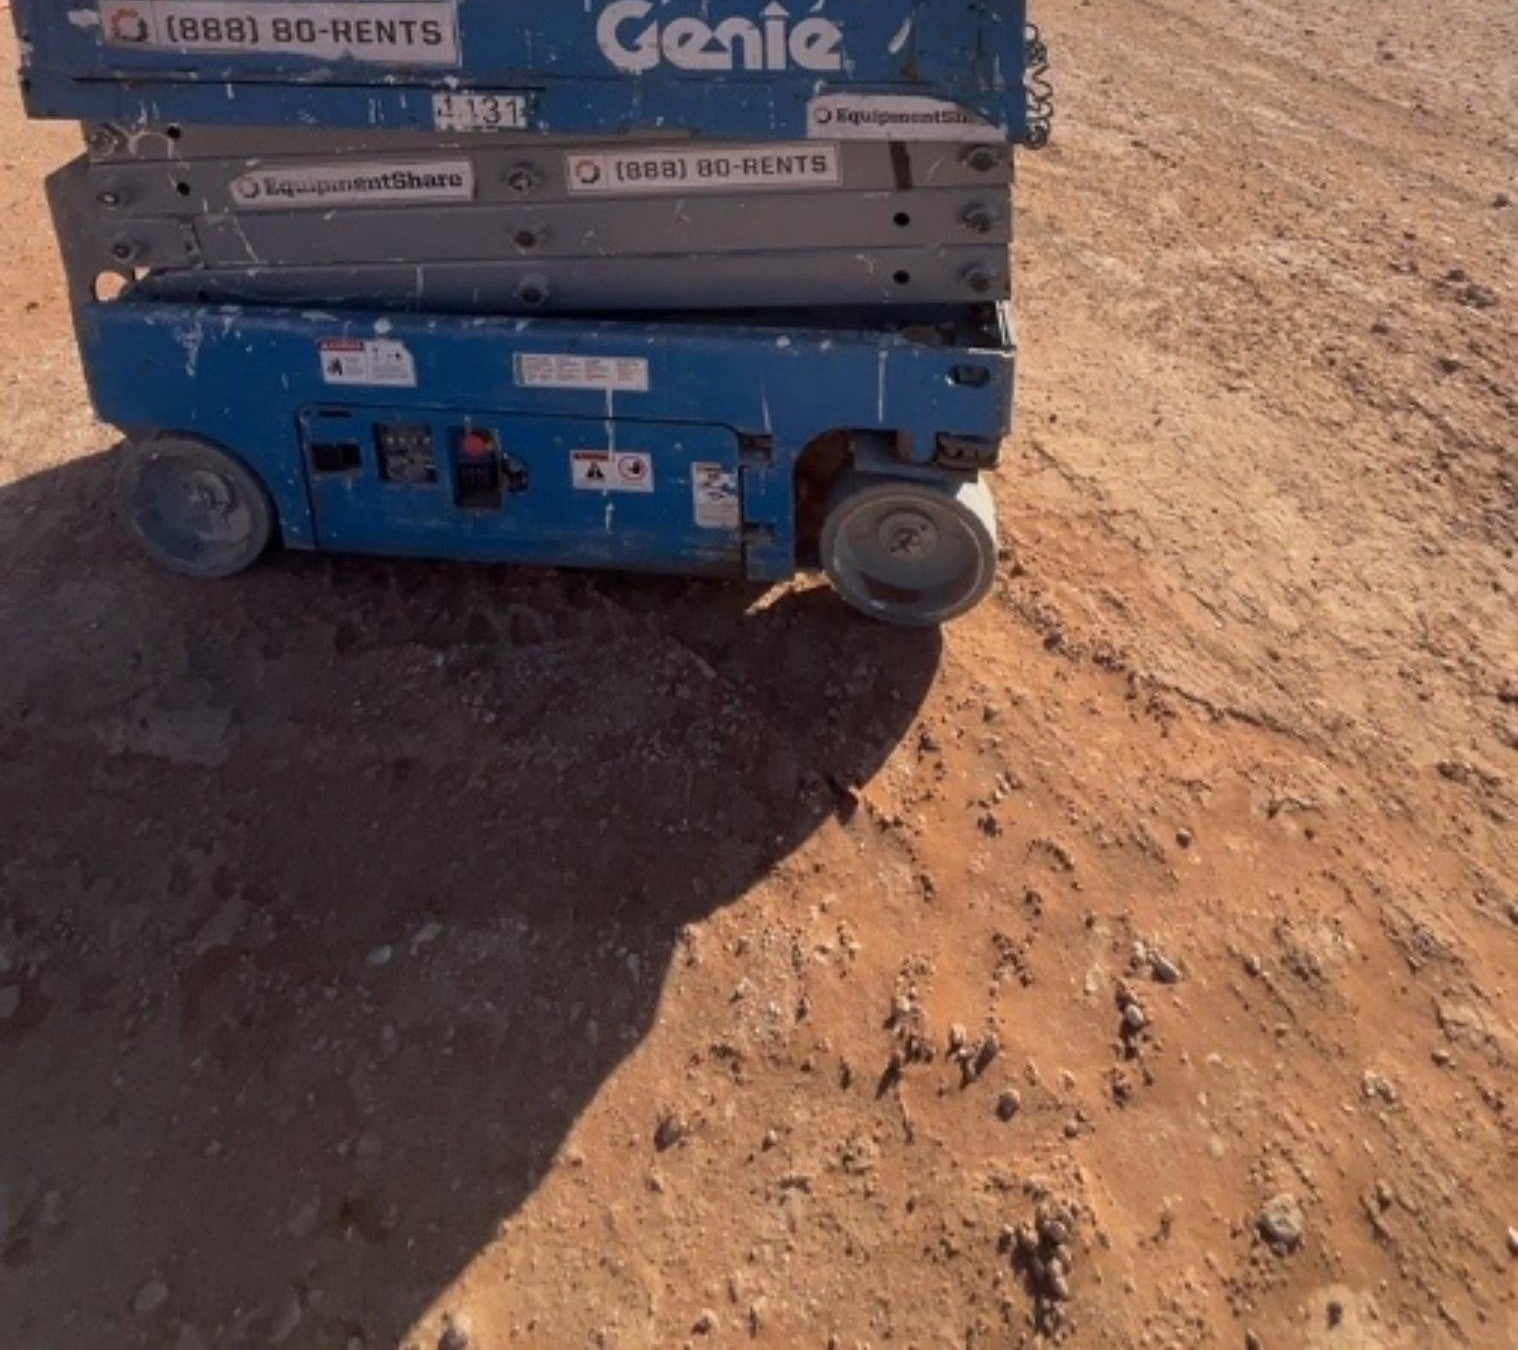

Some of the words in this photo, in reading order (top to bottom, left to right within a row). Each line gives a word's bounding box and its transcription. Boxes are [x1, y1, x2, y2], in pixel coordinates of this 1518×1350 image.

[166, 15, 259, 44] (888)
[271, 17, 442, 46] 80-RENTS
[616, 158, 687, 181] (888)
[696, 154, 827, 178] 80-RENTS
[263, 169, 463, 198] EquipmentShare
